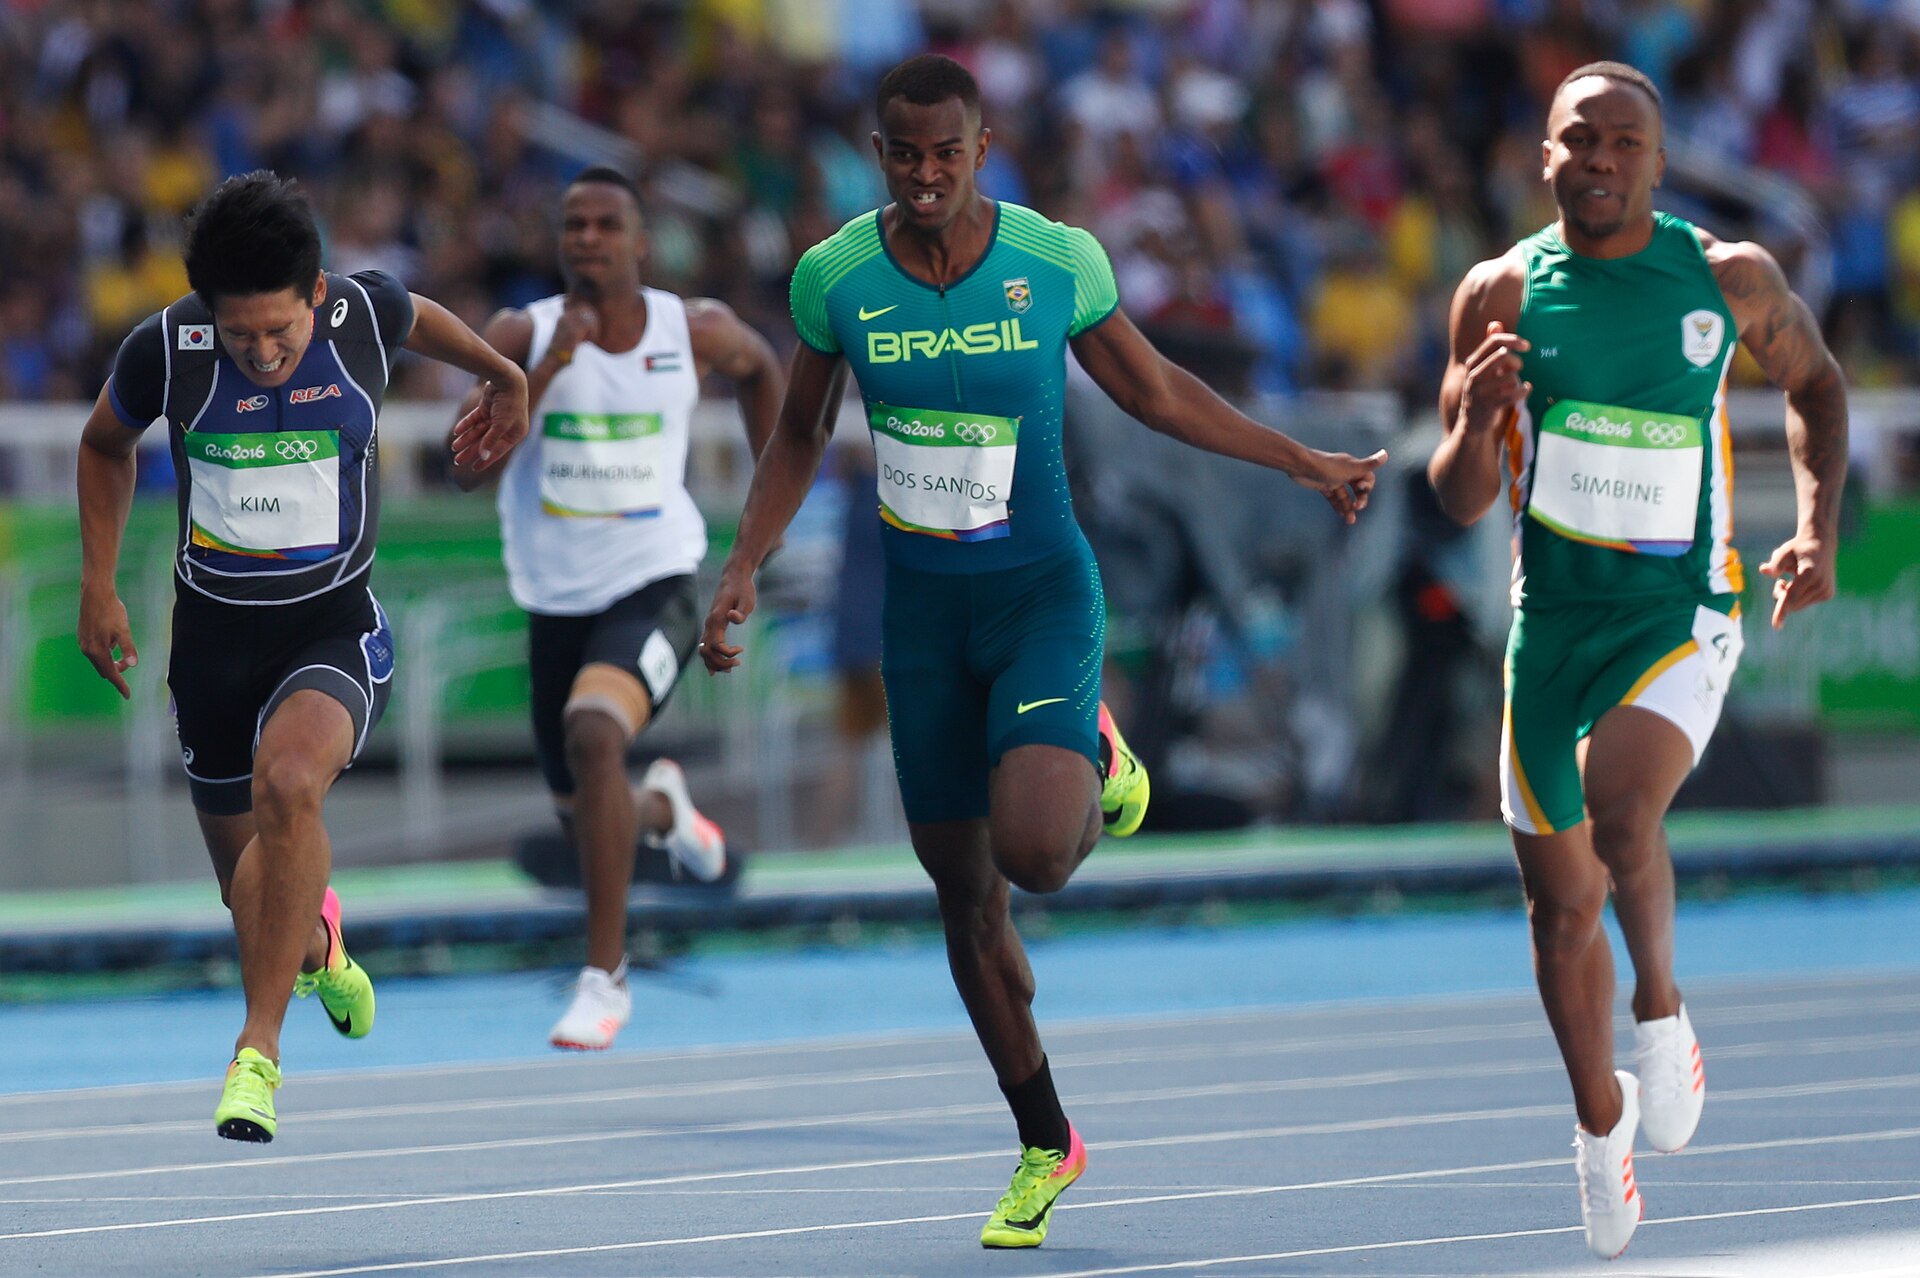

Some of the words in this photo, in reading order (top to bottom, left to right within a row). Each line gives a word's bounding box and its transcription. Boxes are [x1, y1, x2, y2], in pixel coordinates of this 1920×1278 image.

[867, 317, 1039, 364] BRASIL
[886, 416, 945, 438] Rio2016
[1565, 412, 1633, 438] Rio2016
[205, 443, 265, 460] Rio2016
[883, 463, 916, 489] DOS
[923, 474, 997, 502] SANTOS
[1570, 472, 1665, 505] SIMBINE
[240, 496, 281, 513] KIM
